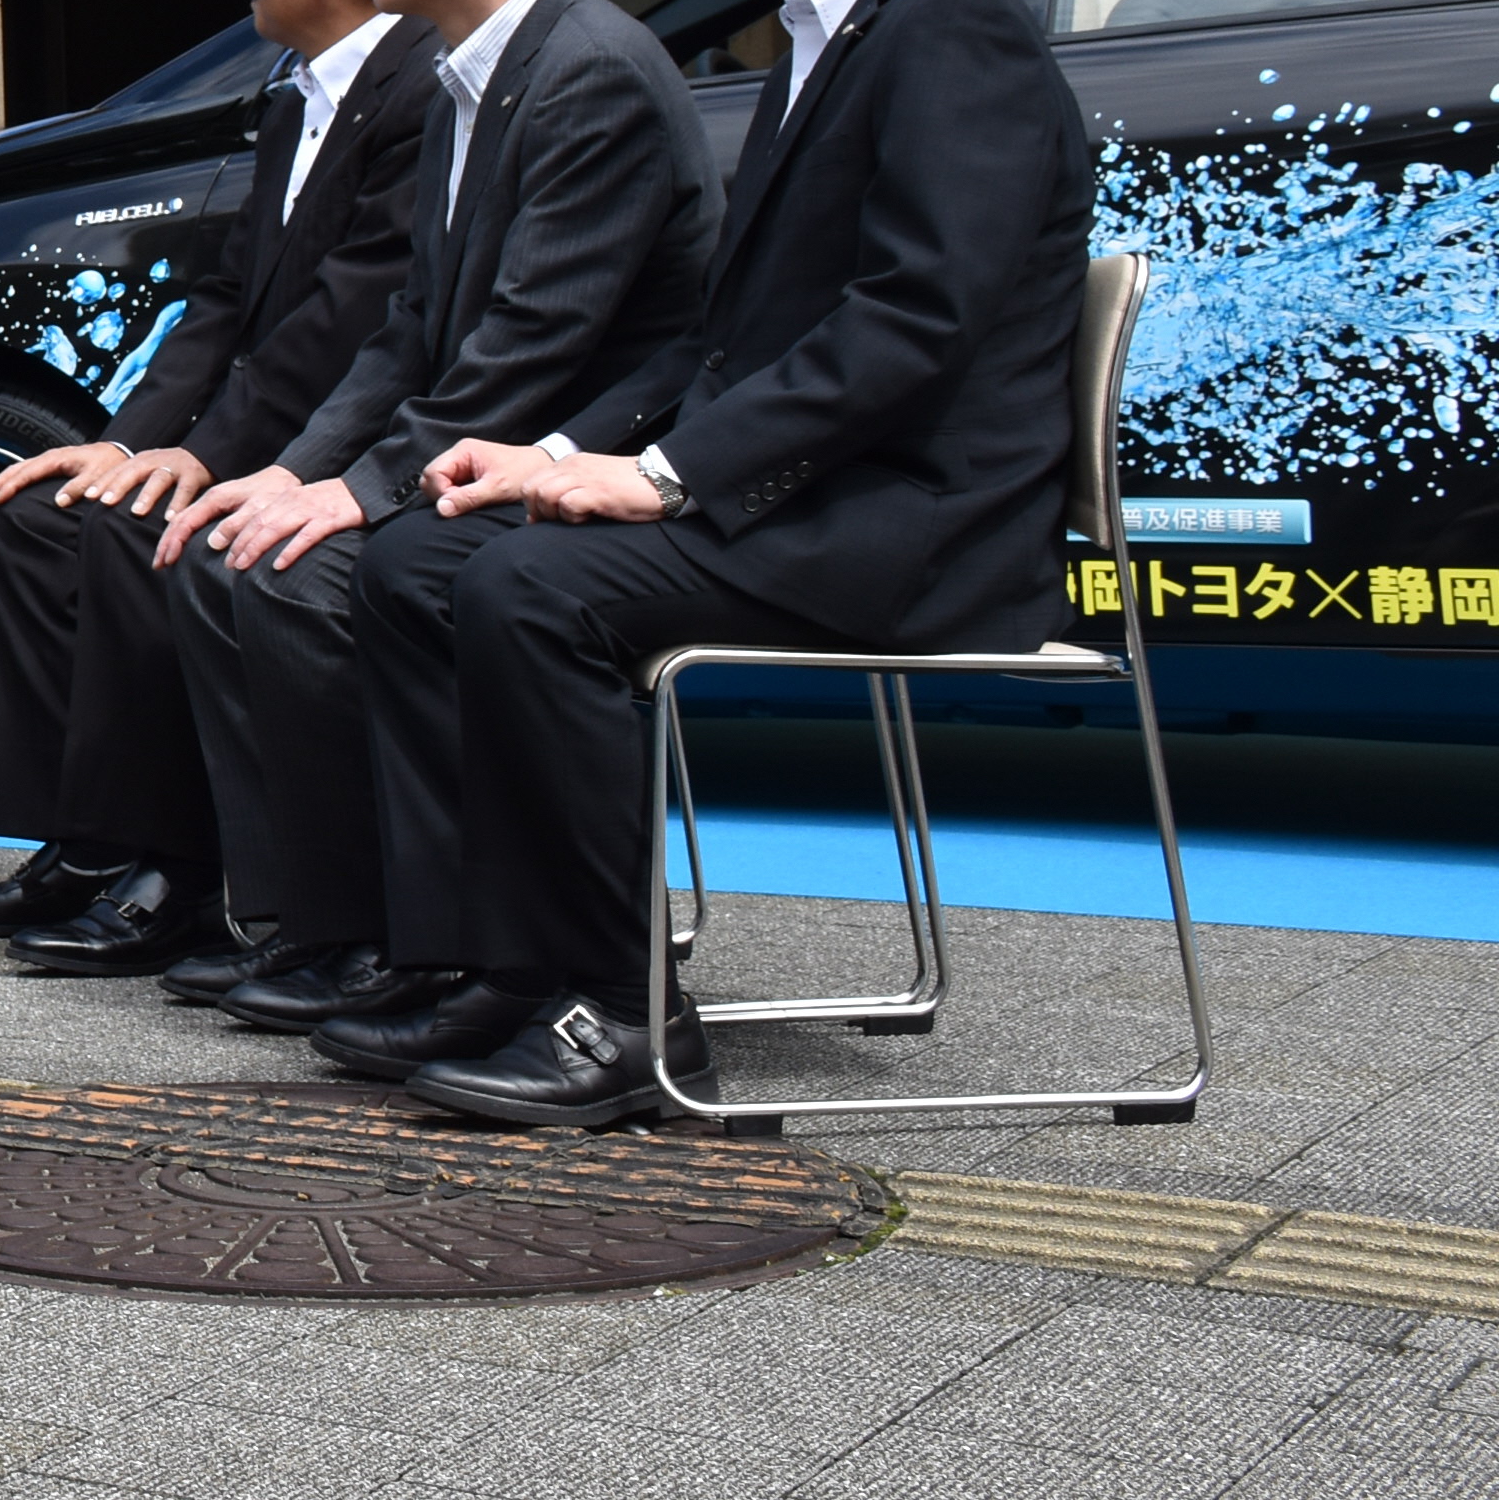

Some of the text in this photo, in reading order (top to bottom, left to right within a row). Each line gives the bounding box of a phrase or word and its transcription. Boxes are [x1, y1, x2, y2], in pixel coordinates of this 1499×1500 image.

[1066, 560, 1499, 626] 岡トヨタ×静岡
